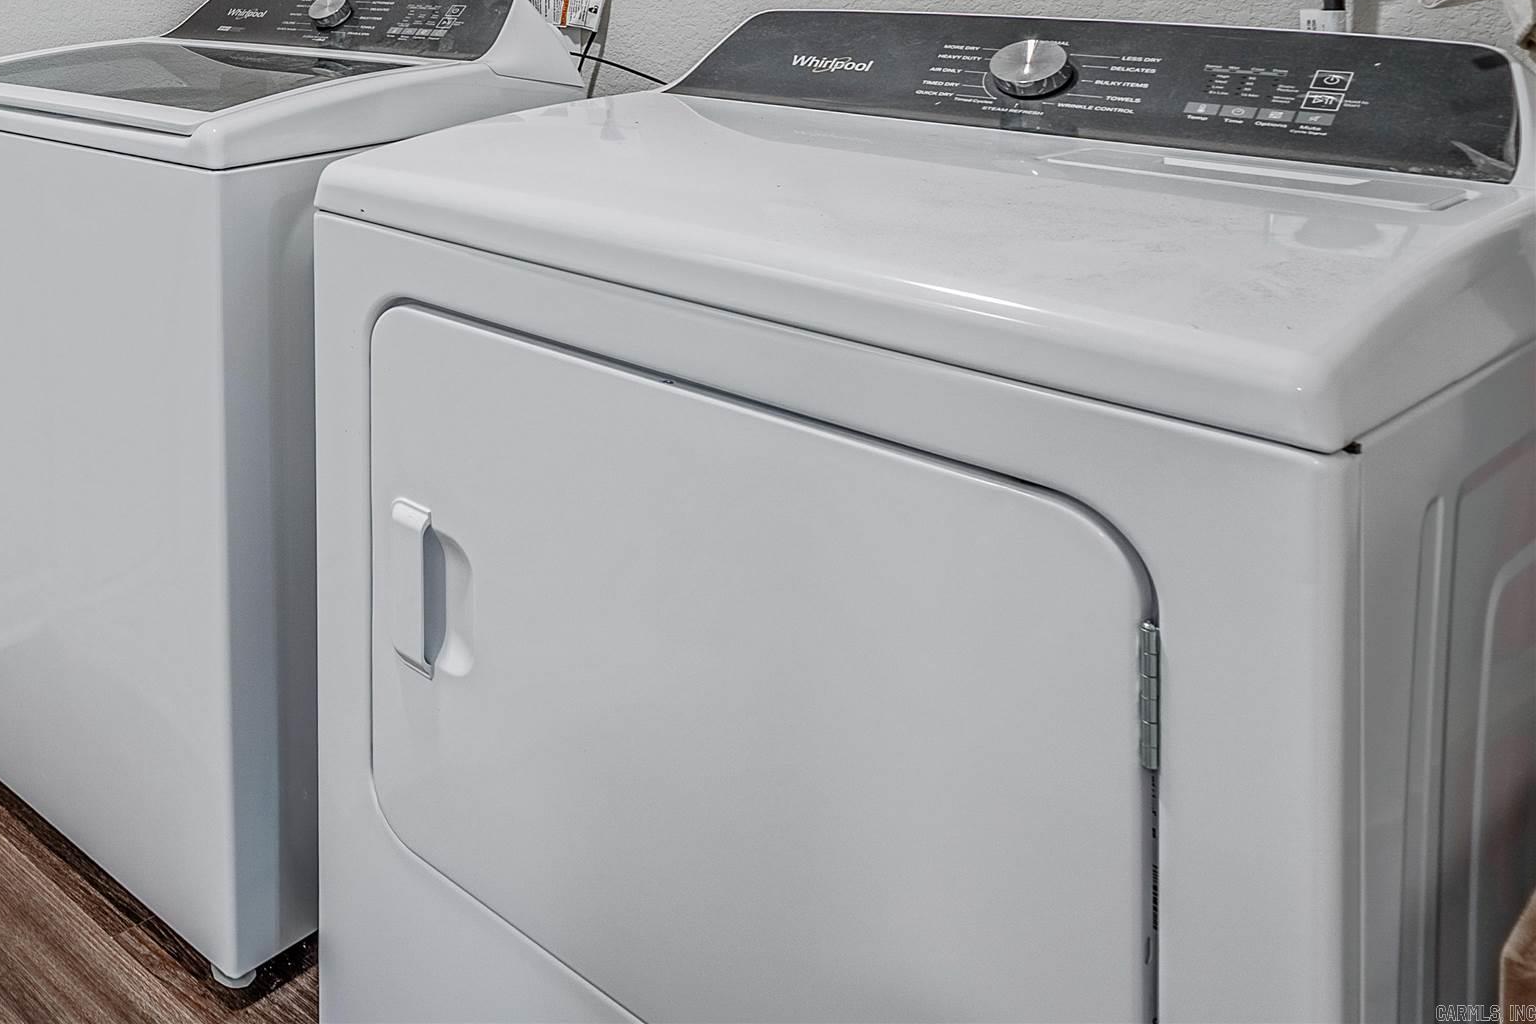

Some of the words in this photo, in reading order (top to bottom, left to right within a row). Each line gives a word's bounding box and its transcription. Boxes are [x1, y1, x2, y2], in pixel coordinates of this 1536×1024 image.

[227, 8, 268, 20] Whirlpool
[943, 43, 963, 51] MORE
[937, 53, 962, 61] HEAVY
[962, 54, 983, 62] DUTY
[1121, 55, 1144, 63] LESS
[791, 54, 874, 74] Whirlpool
[1110, 65, 1157, 74] DELICATES
[922, 79, 944, 87] TIMED
[944, 80, 960, 88] DRY
[1094, 79, 1123, 87] BULKY
[1122, 81, 1149, 89] ITEMS
[915, 88, 938, 97] QUICK
[938, 90, 955, 98] DRY
[1105, 95, 1142, 104] TOWELS
[981, 105, 1008, 114] STEAM
[1007, 107, 1045, 117] REFRESH
[1057, 102, 1094, 111] WRINKLE
[1094, 105, 1135, 115] CONTROL
[1186, 114, 1209, 122] Temp
[1223, 117, 1245, 125] Time
[1254, 120, 1288, 129] Options
[1299, 124, 1322, 132] Mute
